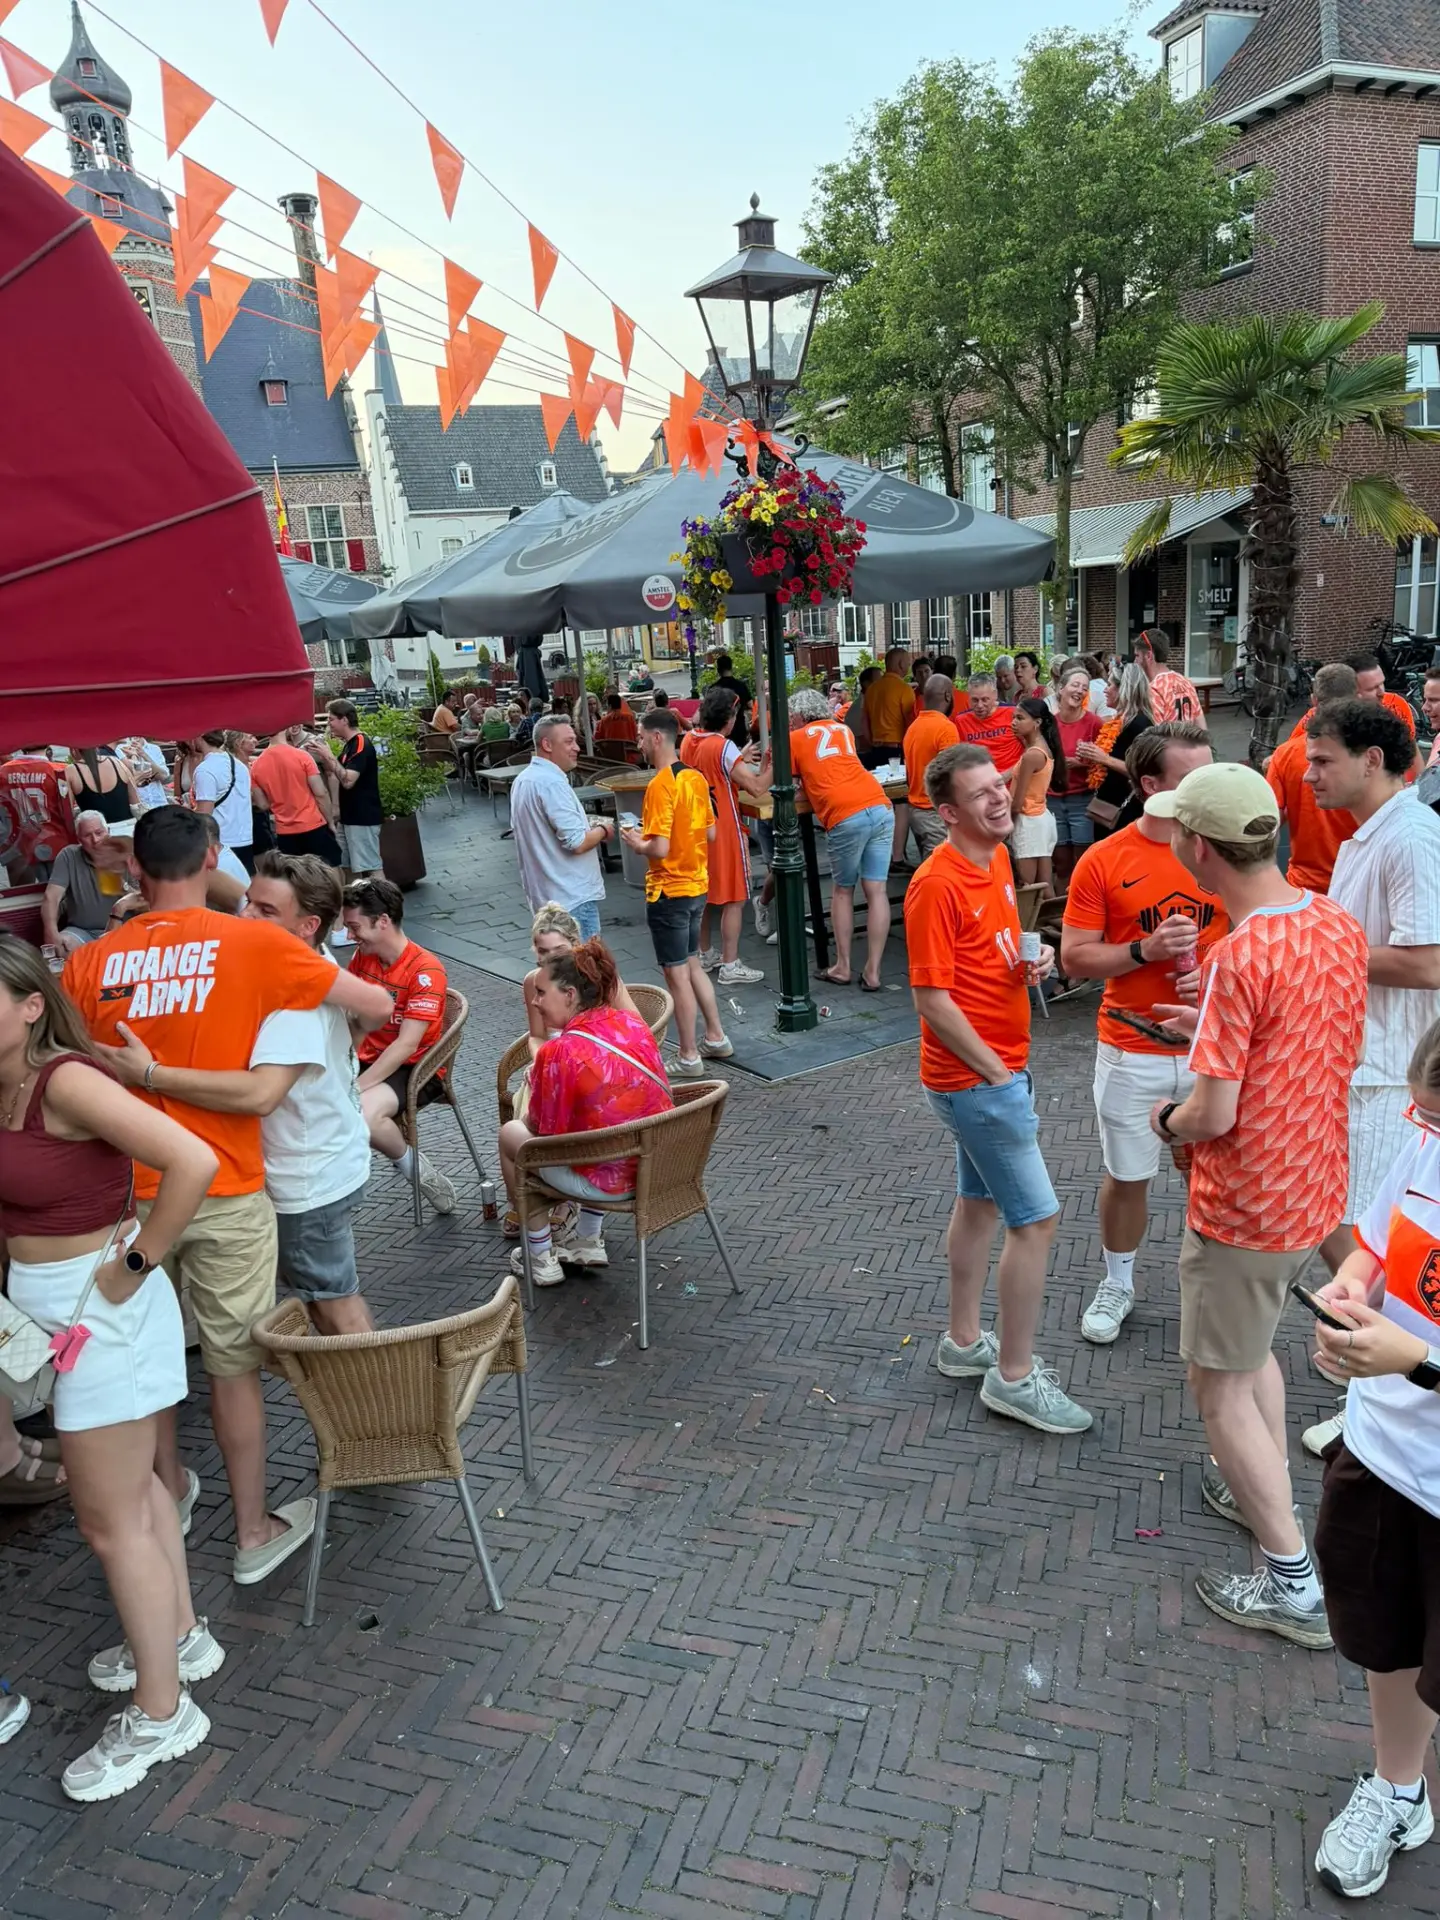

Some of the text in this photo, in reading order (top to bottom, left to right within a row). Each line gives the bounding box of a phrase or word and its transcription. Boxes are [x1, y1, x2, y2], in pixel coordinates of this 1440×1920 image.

[829, 463, 876, 499] STEL
[866, 488, 908, 514] BIER
[648, 586, 674, 594] AMSTEL
[1198, 588, 1233, 603] SMELT
[1048, 597, 1074, 611] SLT
[807, 724, 854, 759] 27
[967, 727, 1006, 741] DUTCHY
[7, 772, 47, 785] BERGKAMP
[102, 940, 221, 987] ORANGE
[127, 977, 216, 1019] ARMY
